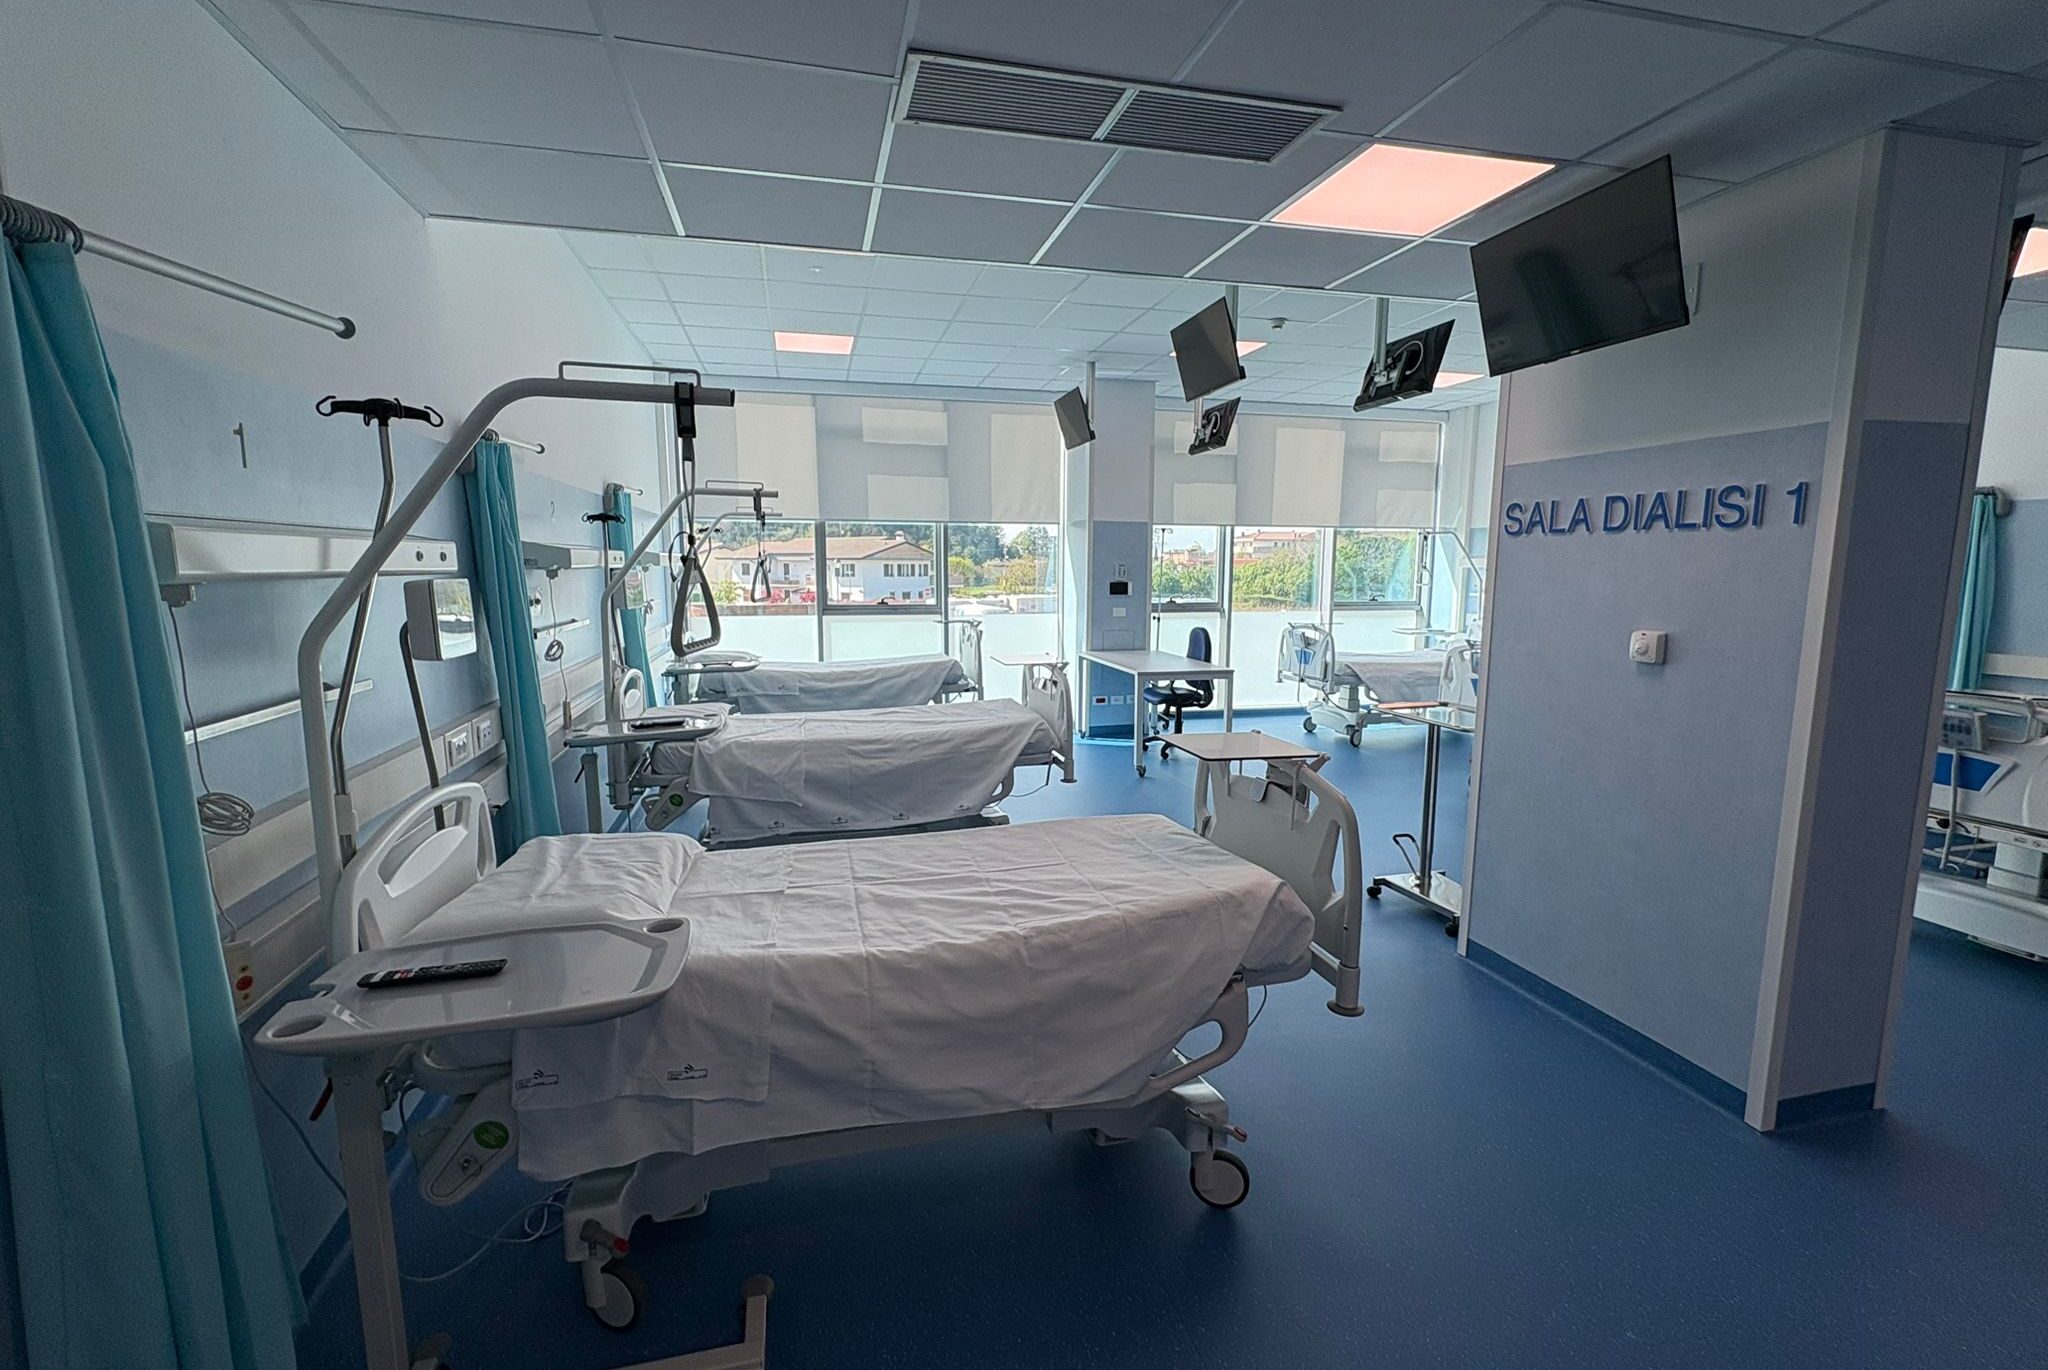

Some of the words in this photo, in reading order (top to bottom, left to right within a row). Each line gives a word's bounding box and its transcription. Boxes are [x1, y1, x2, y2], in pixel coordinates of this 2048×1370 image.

[1504, 498, 1592, 536] SALA
[1603, 484, 1766, 532] DIALISI
[1786, 482, 1809, 525] 1
